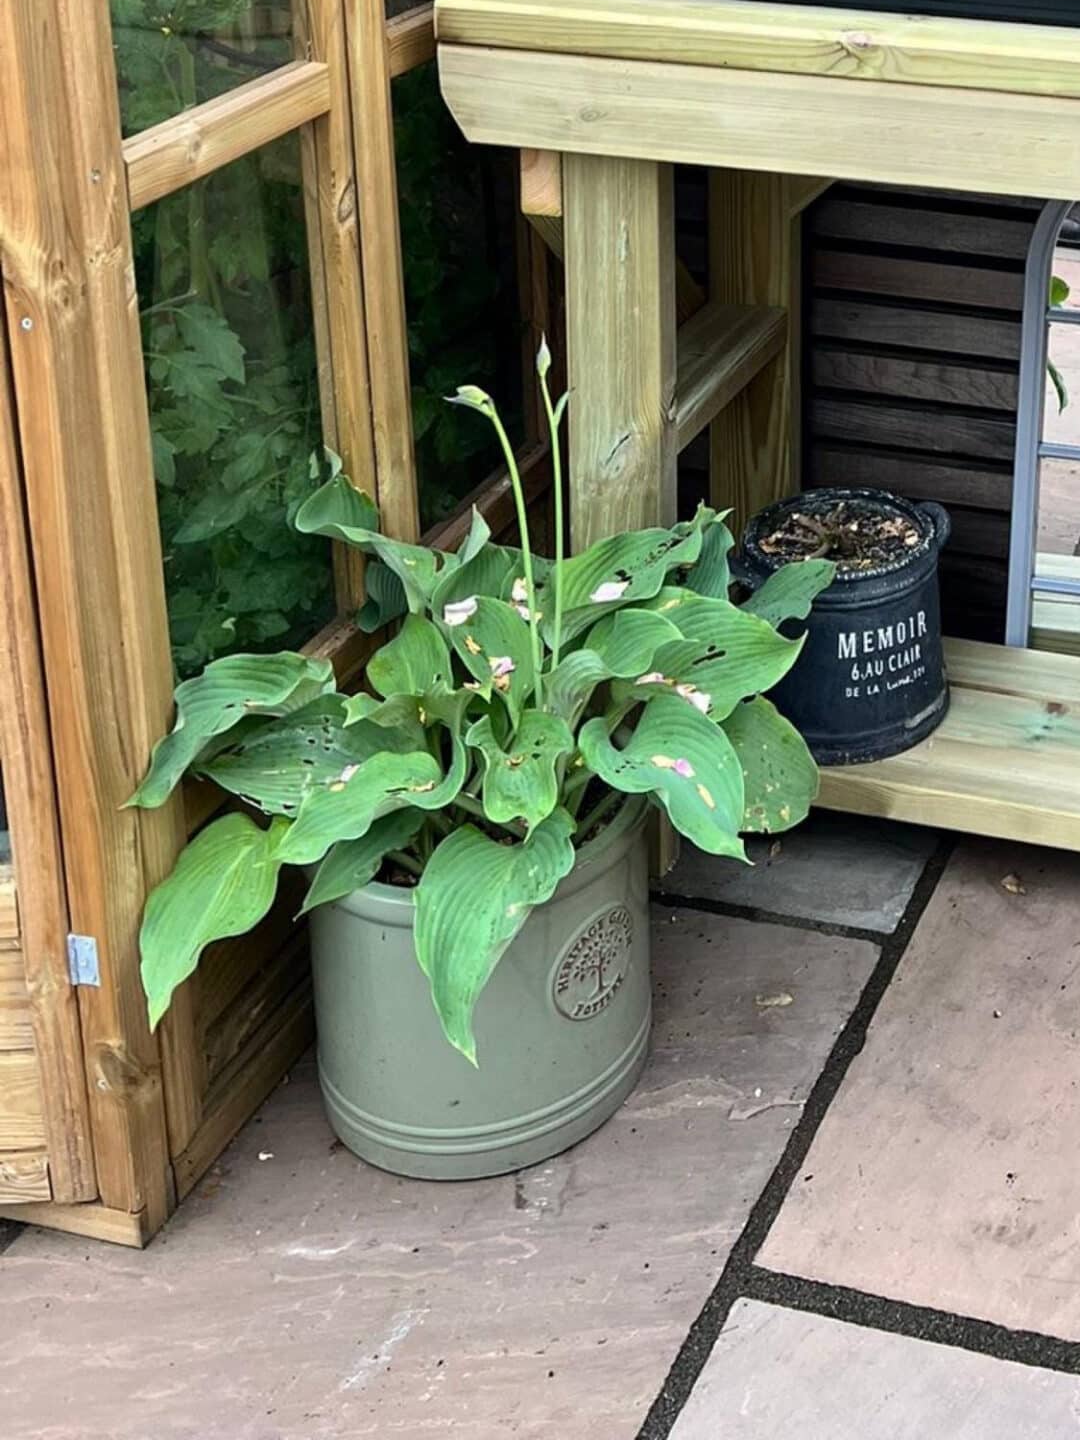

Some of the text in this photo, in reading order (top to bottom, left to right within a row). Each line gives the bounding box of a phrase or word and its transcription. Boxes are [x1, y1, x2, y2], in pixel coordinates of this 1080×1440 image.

[837, 610, 928, 660] MEMOIR
[888, 644, 921, 672] CLAIR
[845, 687, 860, 698] DE
[866, 684, 880, 695] LA
[557, 916, 606, 995] HERITAGE
